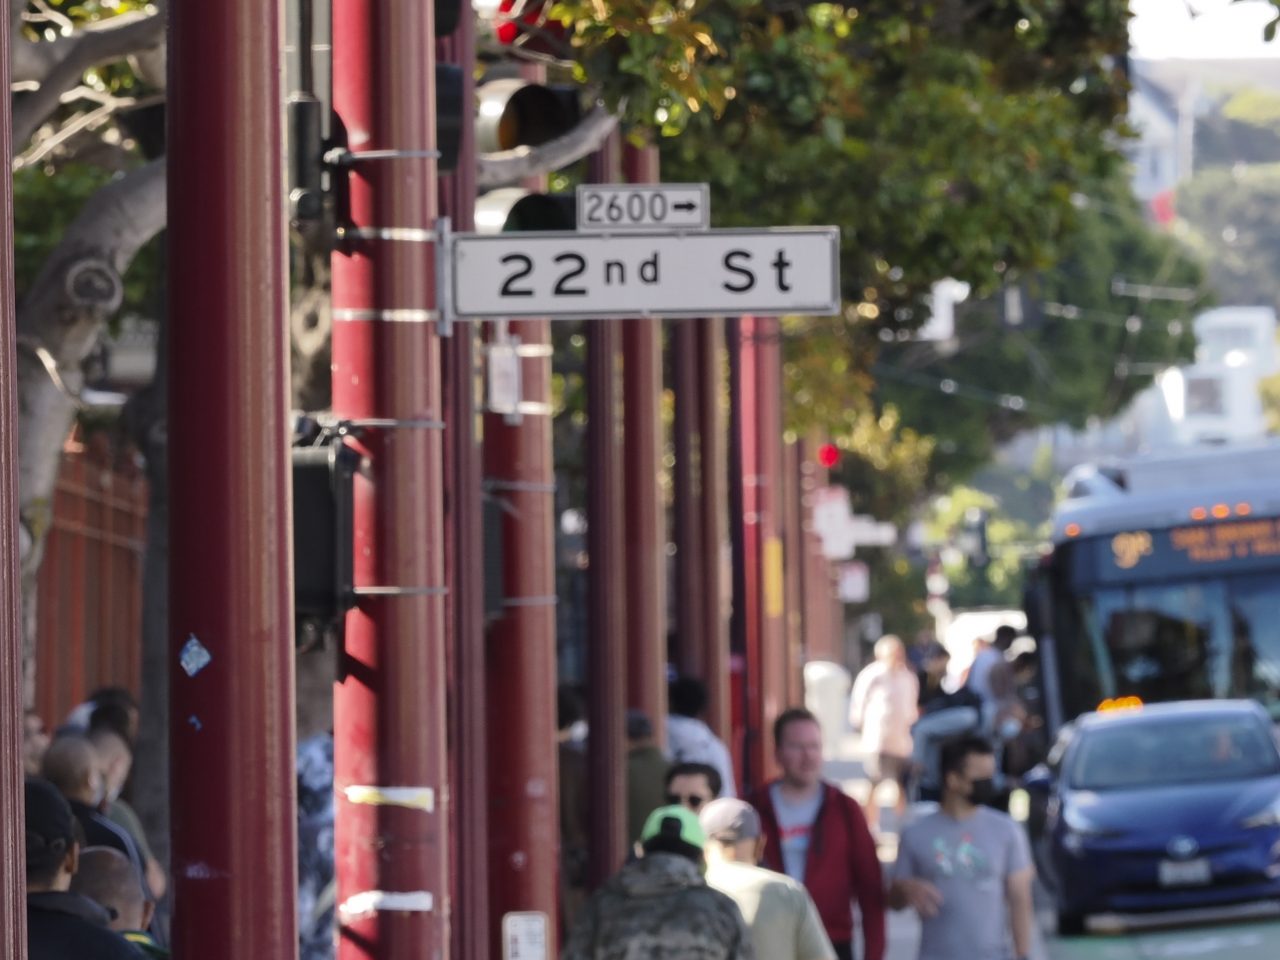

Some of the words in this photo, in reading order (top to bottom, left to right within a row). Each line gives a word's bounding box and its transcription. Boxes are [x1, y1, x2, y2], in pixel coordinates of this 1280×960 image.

[586, 193, 668, 223] 2600
[499, 252, 661, 297] 22nd
[722, 249, 792, 294] St
